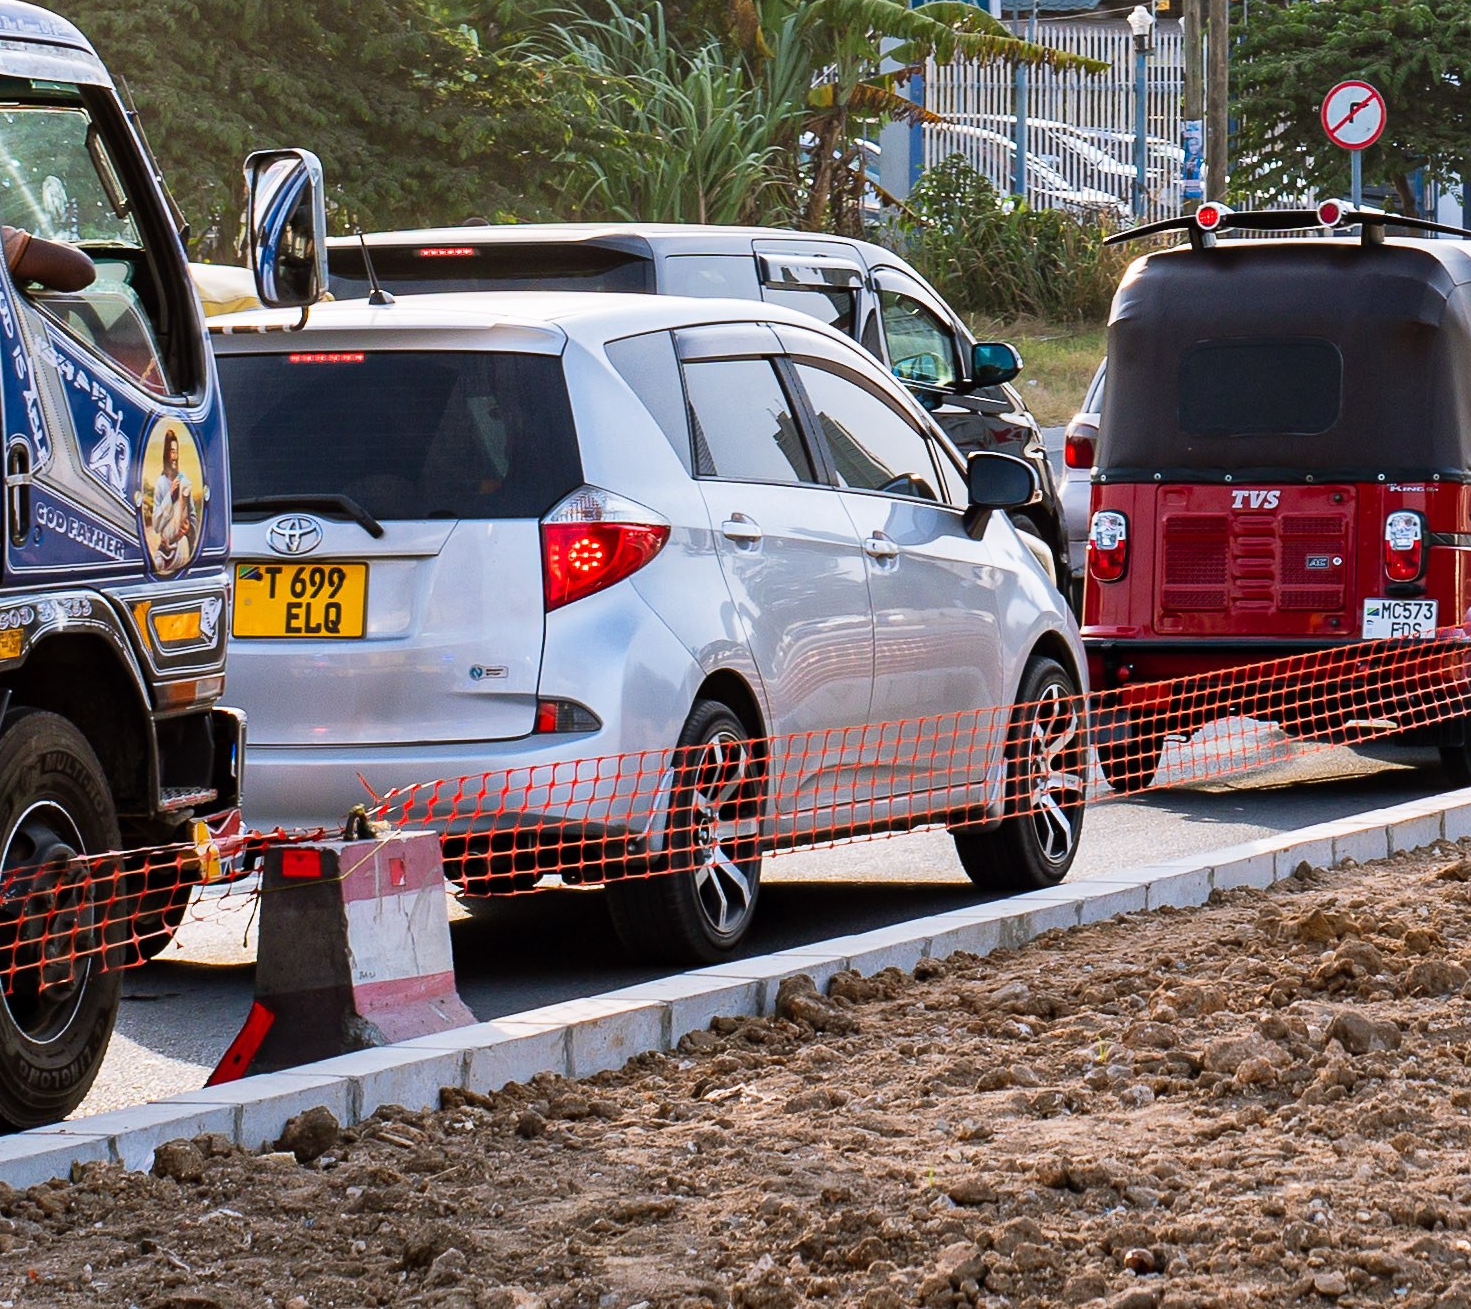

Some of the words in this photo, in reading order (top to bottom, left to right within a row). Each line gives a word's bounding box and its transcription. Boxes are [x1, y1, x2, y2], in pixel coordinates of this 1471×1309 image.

[1232, 490, 1281, 509] TVS
[35, 502, 66, 534] GOD
[67, 517, 126, 560] FATHER
[265, 567, 283, 599] T
[290, 567, 346, 599] 699
[285, 602, 341, 634] ELQ
[1381, 603, 1434, 620] MC573
